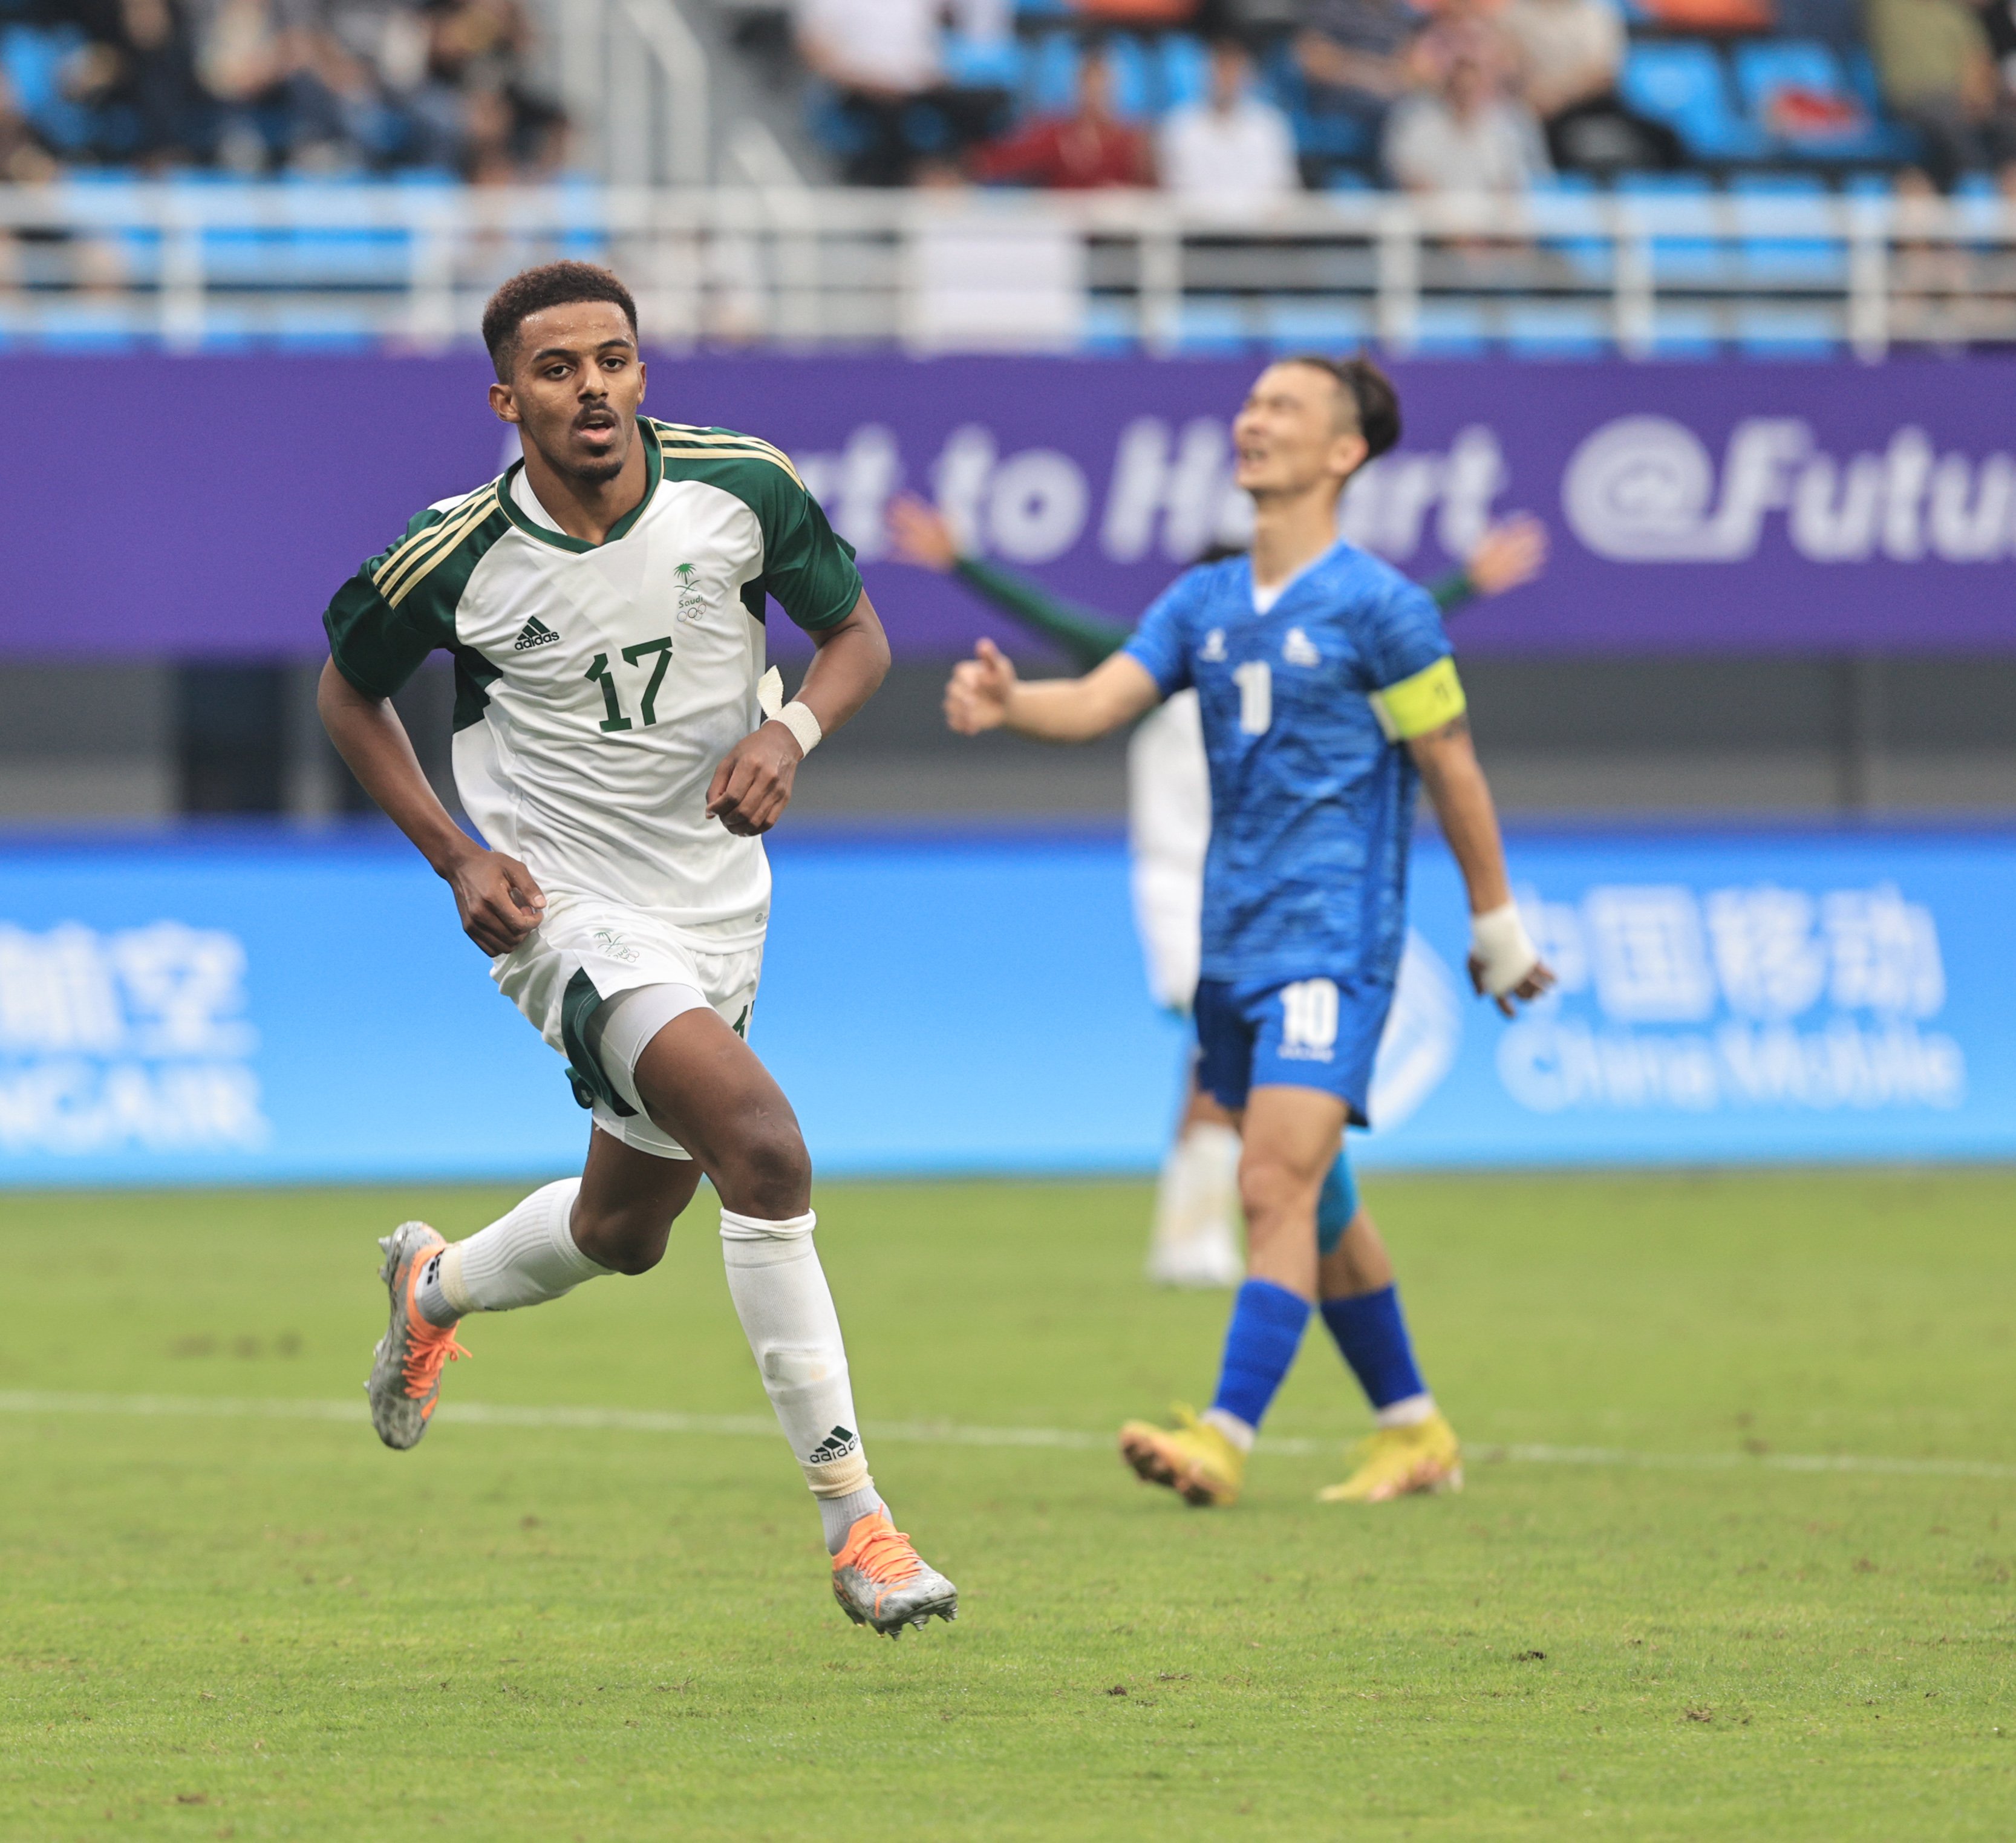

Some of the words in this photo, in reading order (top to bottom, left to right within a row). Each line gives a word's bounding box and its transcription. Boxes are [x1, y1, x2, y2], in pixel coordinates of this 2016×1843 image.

[930, 426, 1089, 563] to
[1562, 414, 2016, 561] @Futu
[679, 595, 703, 608] Saudi
[514, 630, 560, 651] adidas
[584, 636, 673, 734] 17
[1279, 977, 1339, 1048] 10
[810, 1434, 858, 1463] adidas
